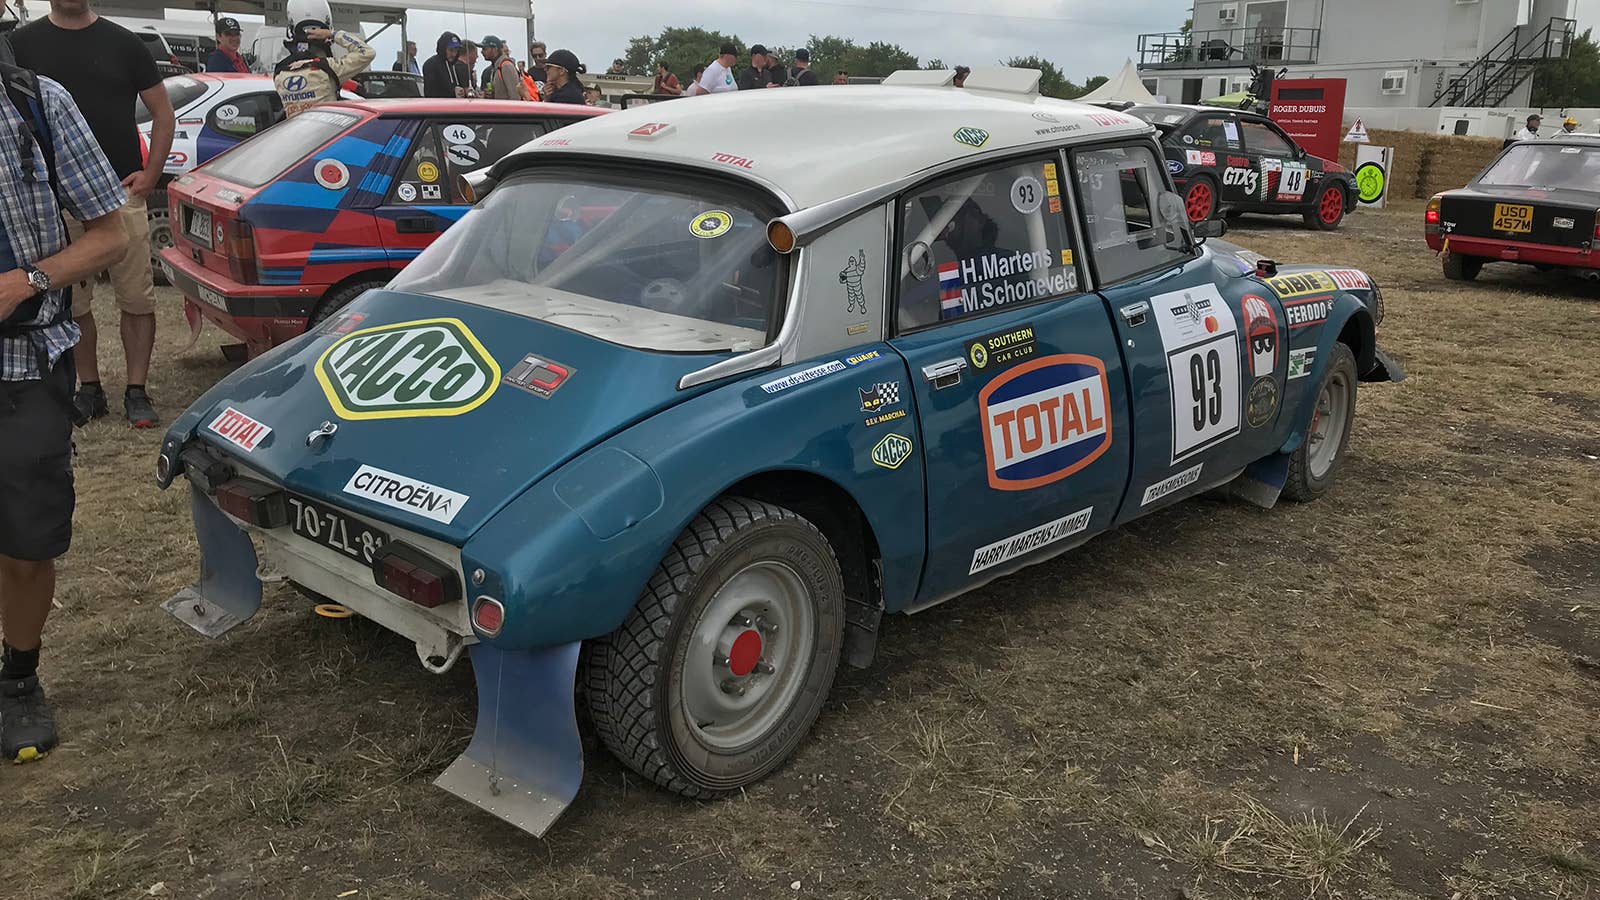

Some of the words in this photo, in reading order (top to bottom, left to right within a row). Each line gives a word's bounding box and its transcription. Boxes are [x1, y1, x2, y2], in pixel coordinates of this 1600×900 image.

[170, 45, 206, 53] NISSAN
[281, 91, 316, 102] HYUNDAI
[221, 107, 234, 117] 30
[1273, 105, 1298, 113] ROGER
[1299, 105, 1327, 113] DUBUIS
[1087, 112, 1130, 127] TOTAL
[452, 129, 467, 140] 46
[711, 152, 754, 169] TOTAL
[1381, 147, 1386, 162] 1
[1223, 166, 1259, 195] GTX3
[1287, 171, 1302, 192] 48
[1019, 184, 1034, 204] 93
[1500, 206, 1528, 218] USO
[1495, 216, 1531, 231] 457M
[961, 249, 1052, 284] H.Martens
[961, 266, 1079, 313] M.Schoneveld
[1270, 274, 1321, 295] CIBIE
[1329, 270, 1370, 289] TOTAL
[1286, 301, 1327, 325] FERODO
[988, 327, 1034, 349] SOUTHERN
[850, 350, 880, 365] QUAIFE
[996, 353, 1012, 363] CAR
[1014, 346, 1034, 357] CLUB
[765, 360, 845, 393] www.ds-vitesse.com
[1190, 349, 1222, 432] 93
[879, 410, 906, 423] MARCHAL
[993, 388, 1104, 460] TOTAL
[212, 408, 265, 449] TOTAL
[875, 438, 907, 465] YACCO
[353, 472, 443, 512] CITROËN
[972, 542, 1010, 570] HARRY
[1006, 525, 1055, 558] MARTENS
